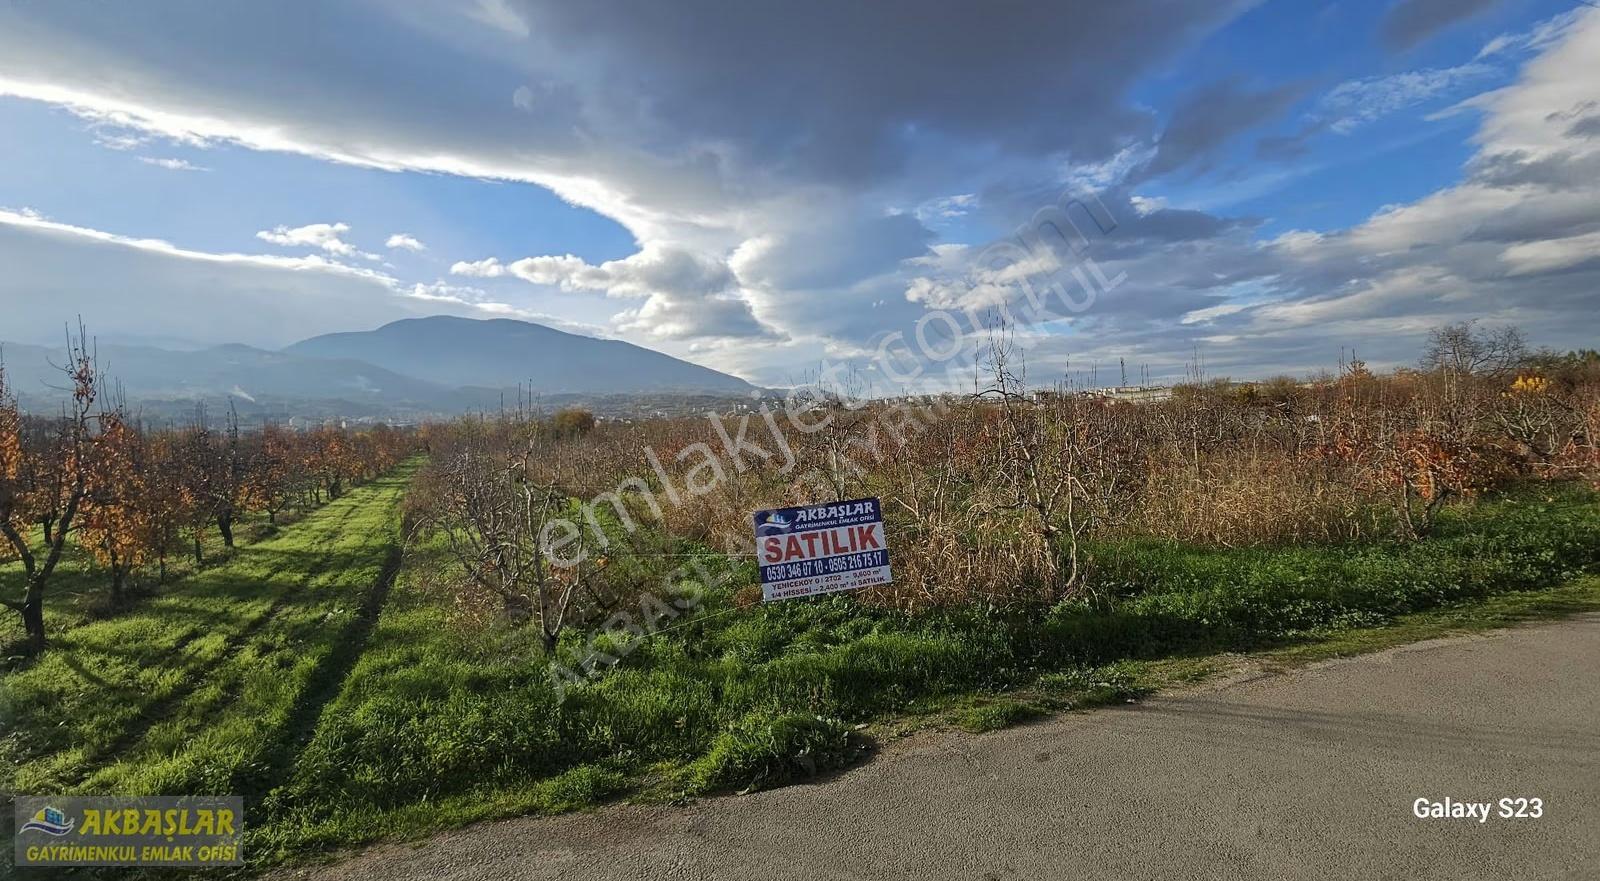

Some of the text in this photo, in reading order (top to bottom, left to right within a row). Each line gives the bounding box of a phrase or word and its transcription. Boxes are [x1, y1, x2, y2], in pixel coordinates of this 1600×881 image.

[795, 502, 875, 522] AKBAŞLAR
[764, 525, 880, 563] SATILIK
[767, 566, 786, 581] 0530
[787, 563, 802, 578] 346
[802, 561, 812, 576] 07
[814, 560, 823, 574] 10
[829, 557, 847, 572] 0505
[849, 554, 862, 569] 216
[863, 553, 873, 566] 75
[873, 551, 883, 565] 17
